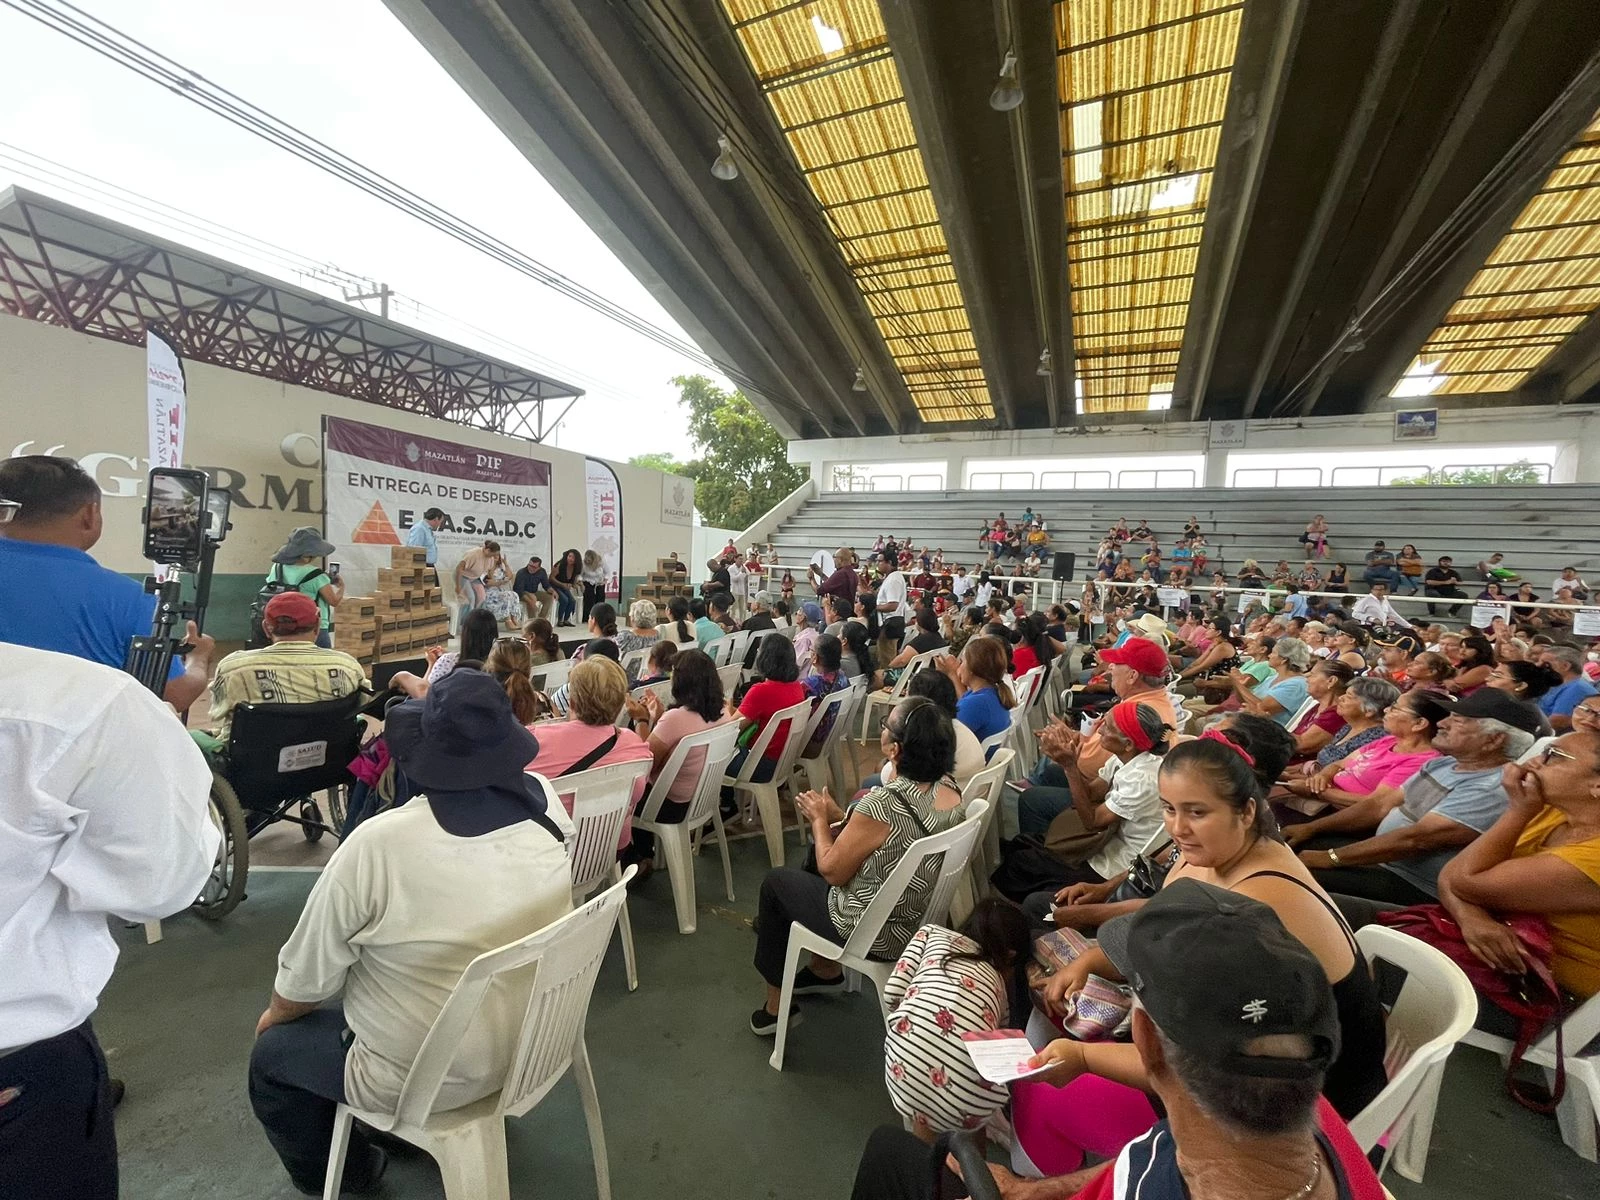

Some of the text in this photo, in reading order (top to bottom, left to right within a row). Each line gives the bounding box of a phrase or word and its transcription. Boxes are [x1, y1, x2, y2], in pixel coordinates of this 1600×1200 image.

[424, 450, 466, 464] MAZATLÁN
[476, 454, 502, 470] DIF
[347, 472, 538, 509] ENTREGA DE DESPENSAS
[600, 489, 616, 528] DIF
